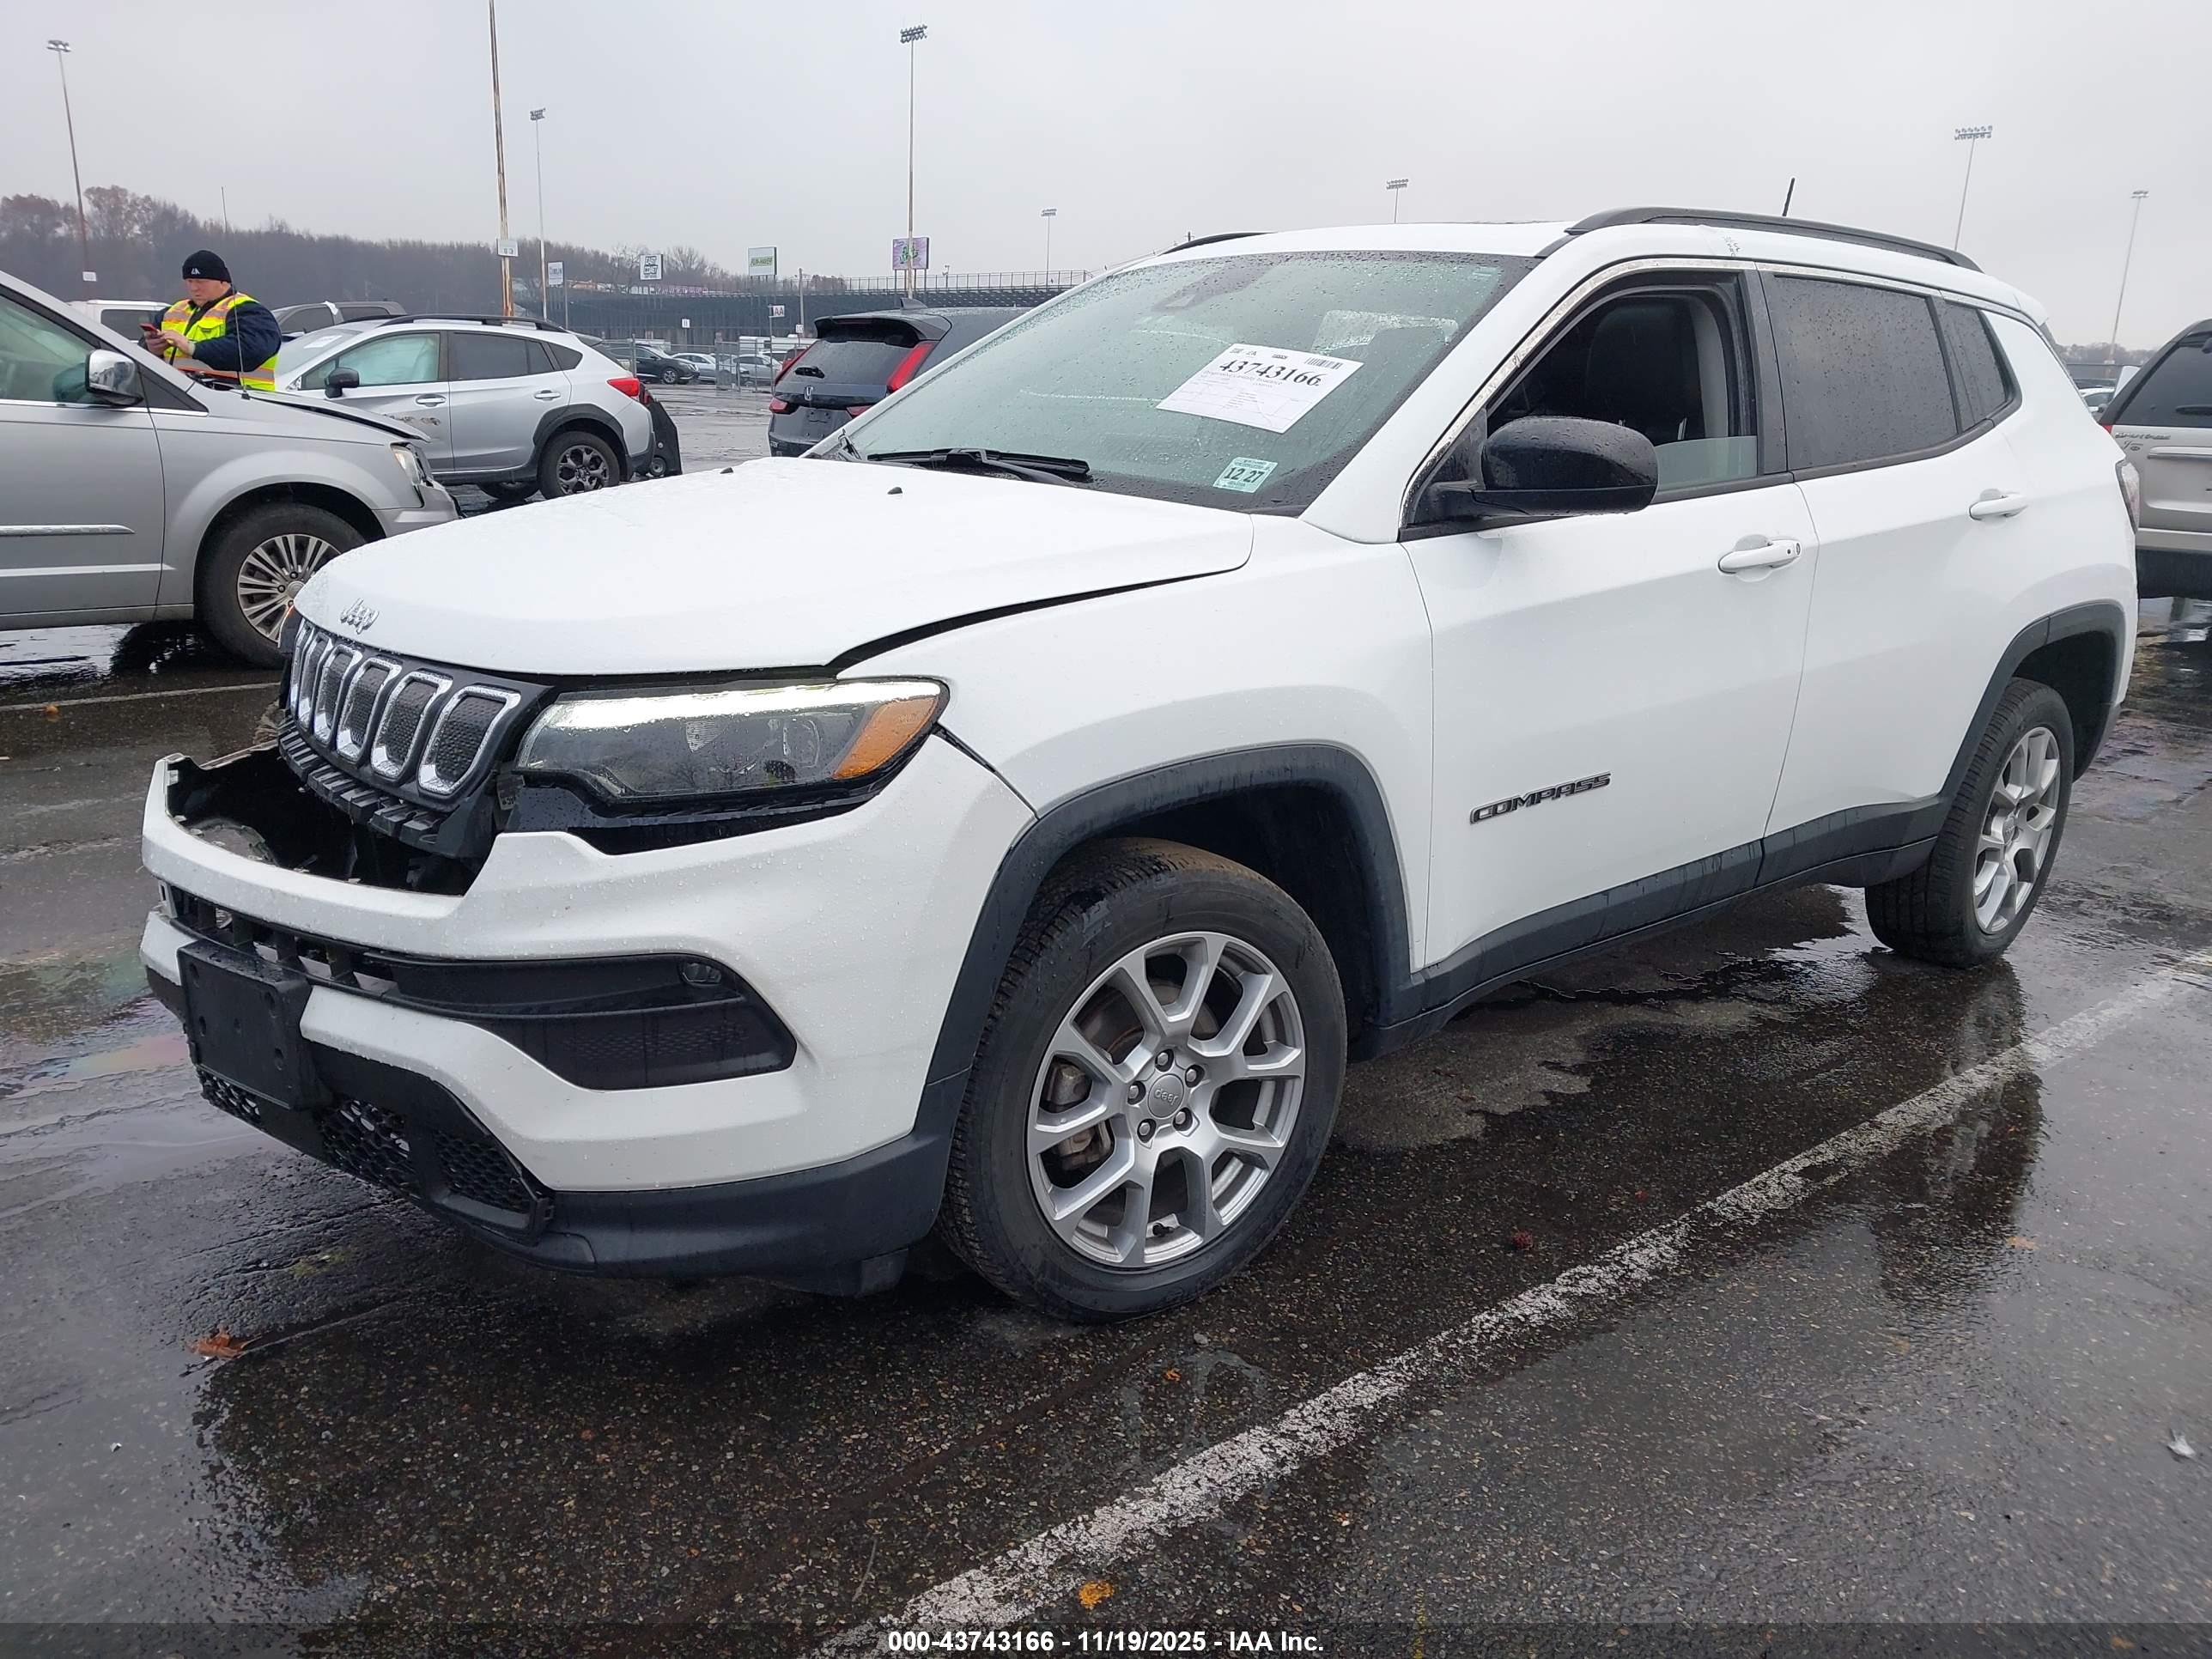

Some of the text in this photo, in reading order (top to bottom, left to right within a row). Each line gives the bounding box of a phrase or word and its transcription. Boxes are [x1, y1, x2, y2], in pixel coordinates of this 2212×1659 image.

[1224, 466, 1265, 483] 12 27
[1469, 771, 1612, 824] COMPASS
